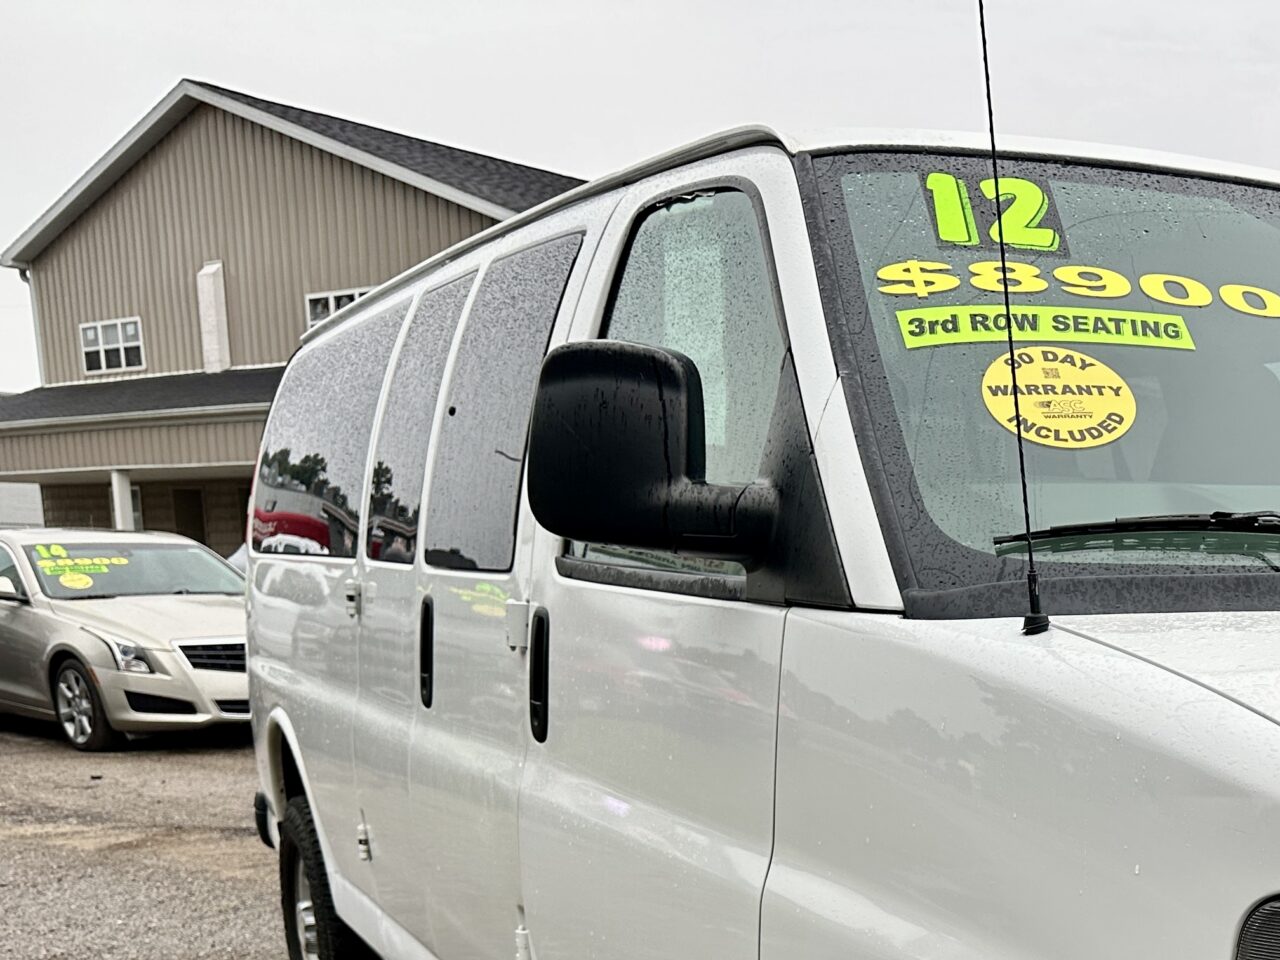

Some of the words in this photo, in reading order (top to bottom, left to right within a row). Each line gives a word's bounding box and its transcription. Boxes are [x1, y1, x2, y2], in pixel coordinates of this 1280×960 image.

[926, 172, 1060, 252] 12
[907, 314, 960, 337] 3rd
[969, 313, 1040, 332] ROW
[1051, 314, 1183, 340] SEATING
[1004, 352, 1034, 369] 90
[1041, 350, 1096, 371] DAY
[987, 384, 1123, 397] WARRANTY
[1006, 412, 1125, 442] INCLUDED
